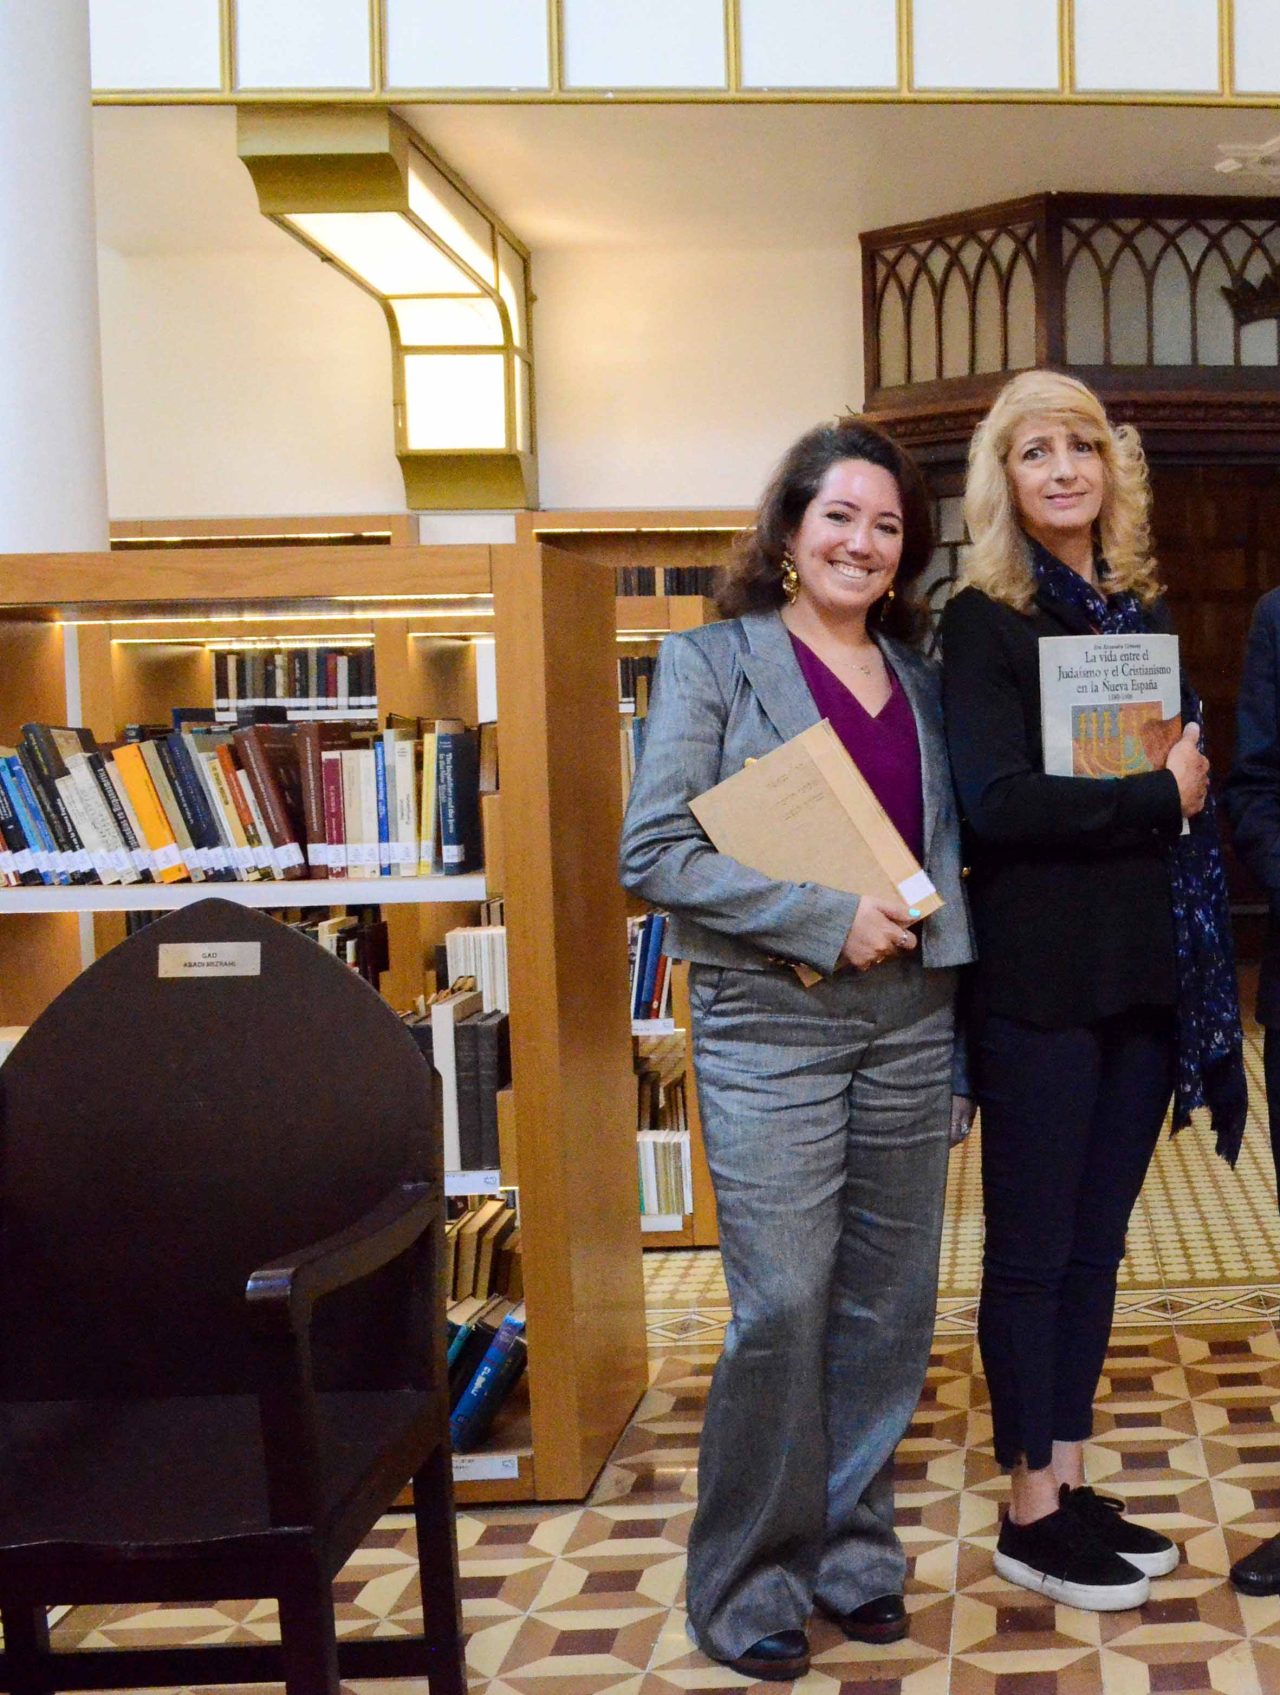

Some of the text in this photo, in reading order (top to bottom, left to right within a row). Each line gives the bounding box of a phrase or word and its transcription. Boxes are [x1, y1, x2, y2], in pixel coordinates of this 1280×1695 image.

[1085, 649, 1149, 663] La vida entre el
[1057, 662, 1172, 681] Judaísmo y el Cristianismo
[1076, 679, 1158, 694] en la Nueva España
